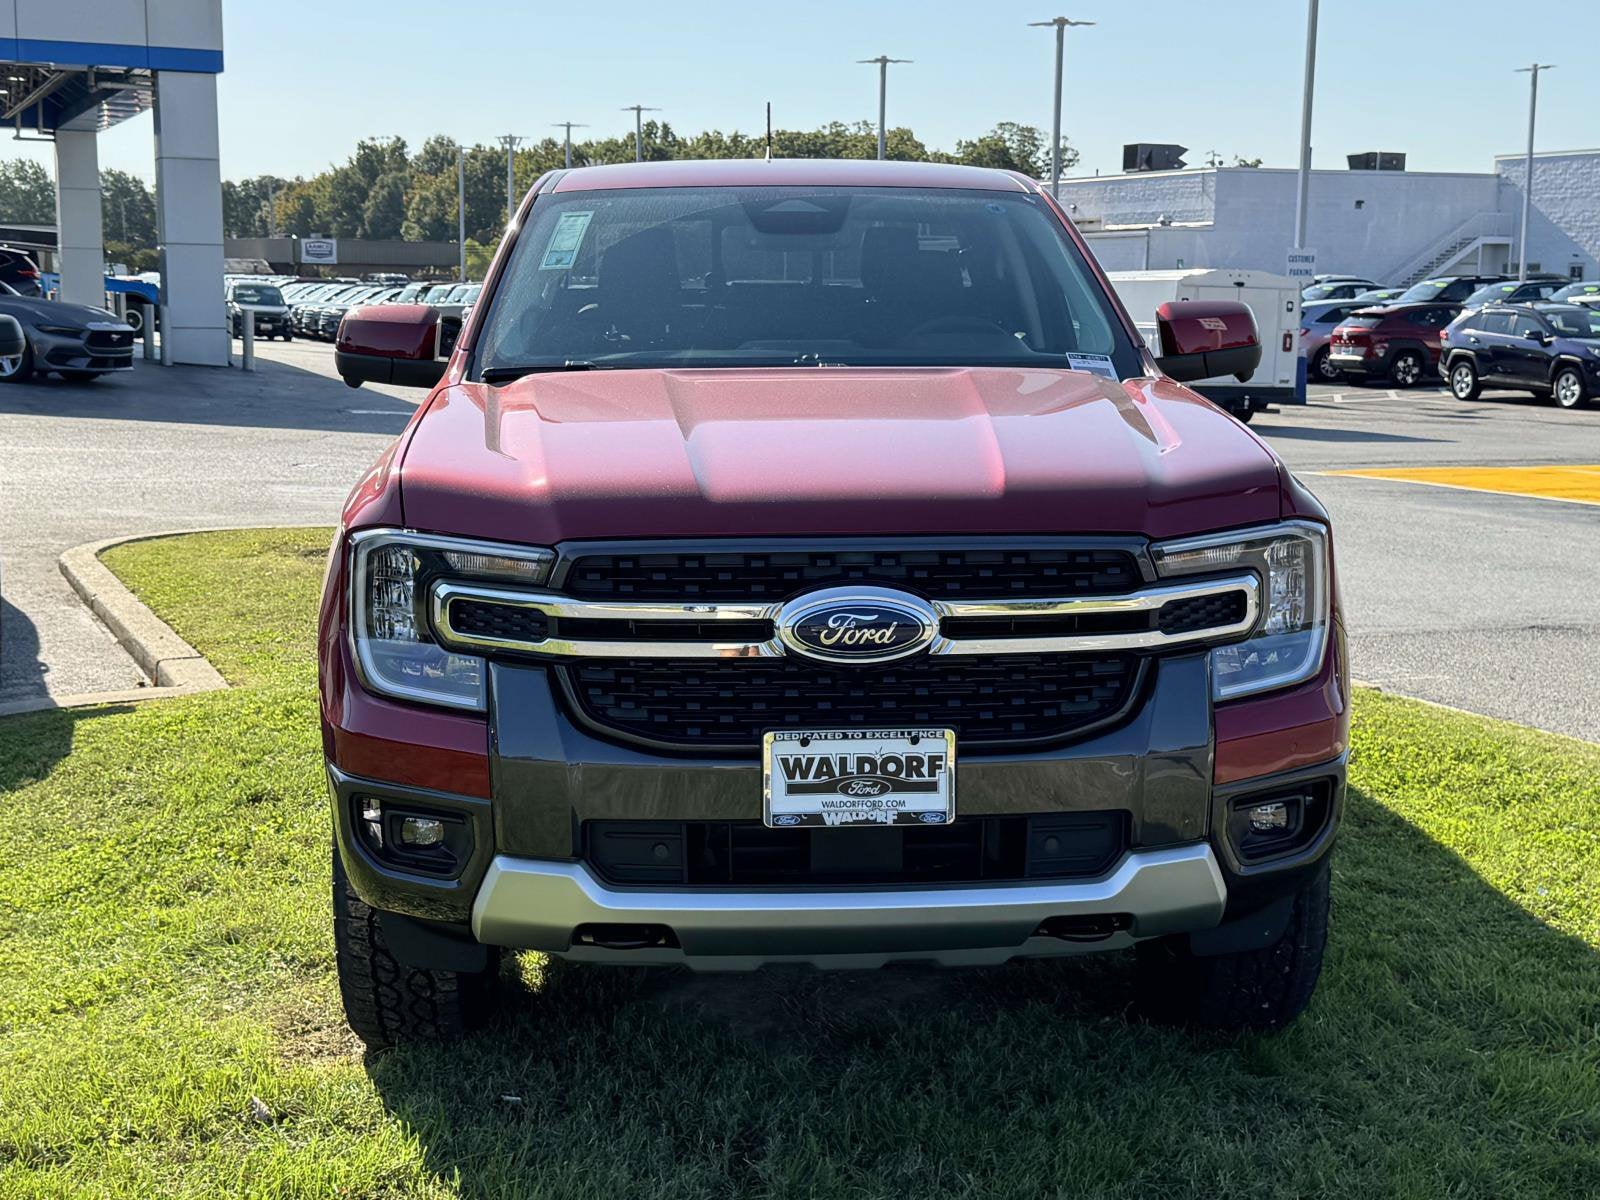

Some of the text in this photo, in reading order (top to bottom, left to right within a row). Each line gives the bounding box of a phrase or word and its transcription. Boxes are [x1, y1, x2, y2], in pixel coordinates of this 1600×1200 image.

[1288, 255, 1315, 263] CUSTOMER
[820, 613, 898, 645] Ford
[775, 730, 943, 741] DEDICATED TO EXCELLENCE
[779, 755, 944, 780] WALDORF
[848, 781, 881, 795] Ford
[821, 800, 906, 808] WALDORFFORD.COM
[821, 809, 898, 826] WALDORF
